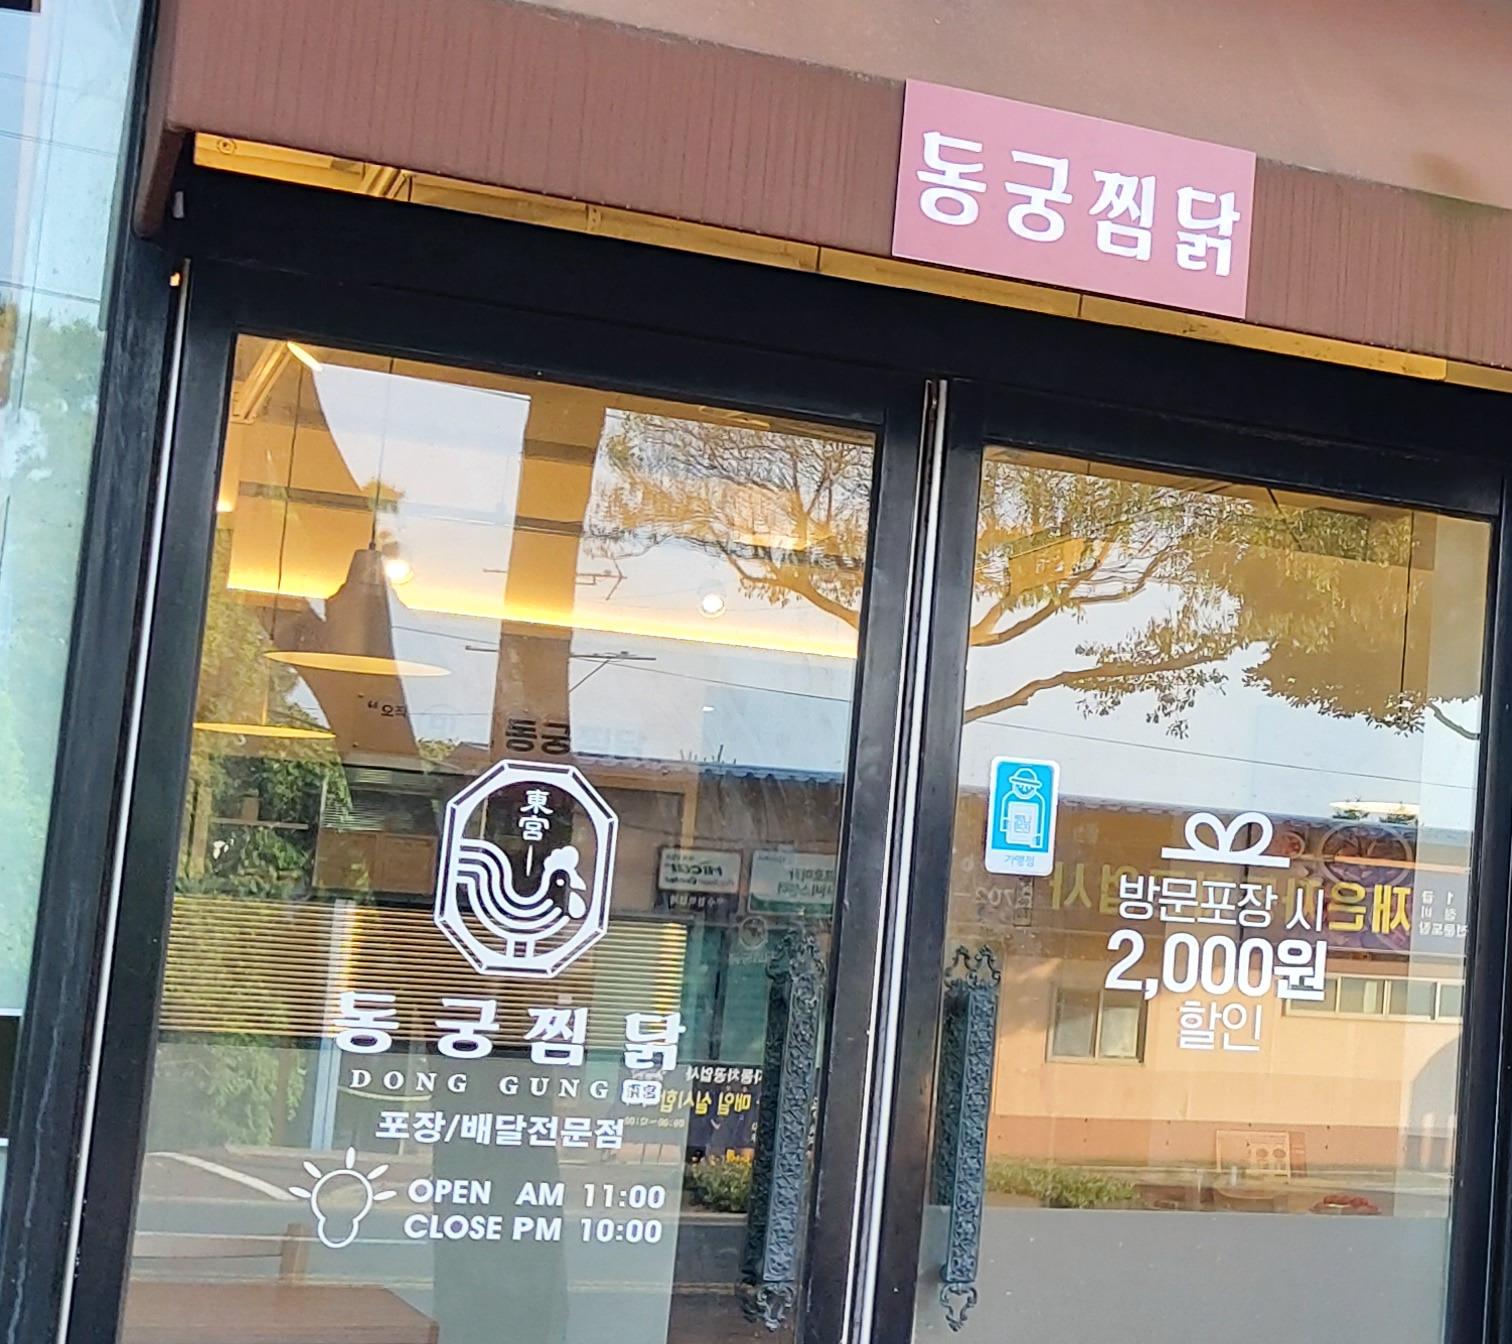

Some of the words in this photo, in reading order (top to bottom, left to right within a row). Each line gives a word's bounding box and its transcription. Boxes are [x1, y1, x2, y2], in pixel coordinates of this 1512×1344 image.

[916, 130, 1241, 277] 동궁찜닭
[518, 787, 555, 843] 東宮
[1118, 873, 1278, 930] 방문포장
[1285, 887, 1326, 933] 시
[1104, 927, 1328, 1002] 2,000원
[332, 990, 688, 1072] 동궁찜닭
[1178, 1000, 1264, 1053] 할인
[350, 1068, 468, 1094] DONG
[499, 1075, 610, 1100] GUNG
[375, 1110, 625, 1150] 포장/배달전문점
[407, 1178, 492, 1205] OPEN
[514, 1182, 565, 1206] AM
[583, 1183, 666, 1209] 11:00
[403, 1213, 502, 1241] CLOSE
[511, 1216, 562, 1241] PM
[580, 1217, 663, 1243] 10:00
